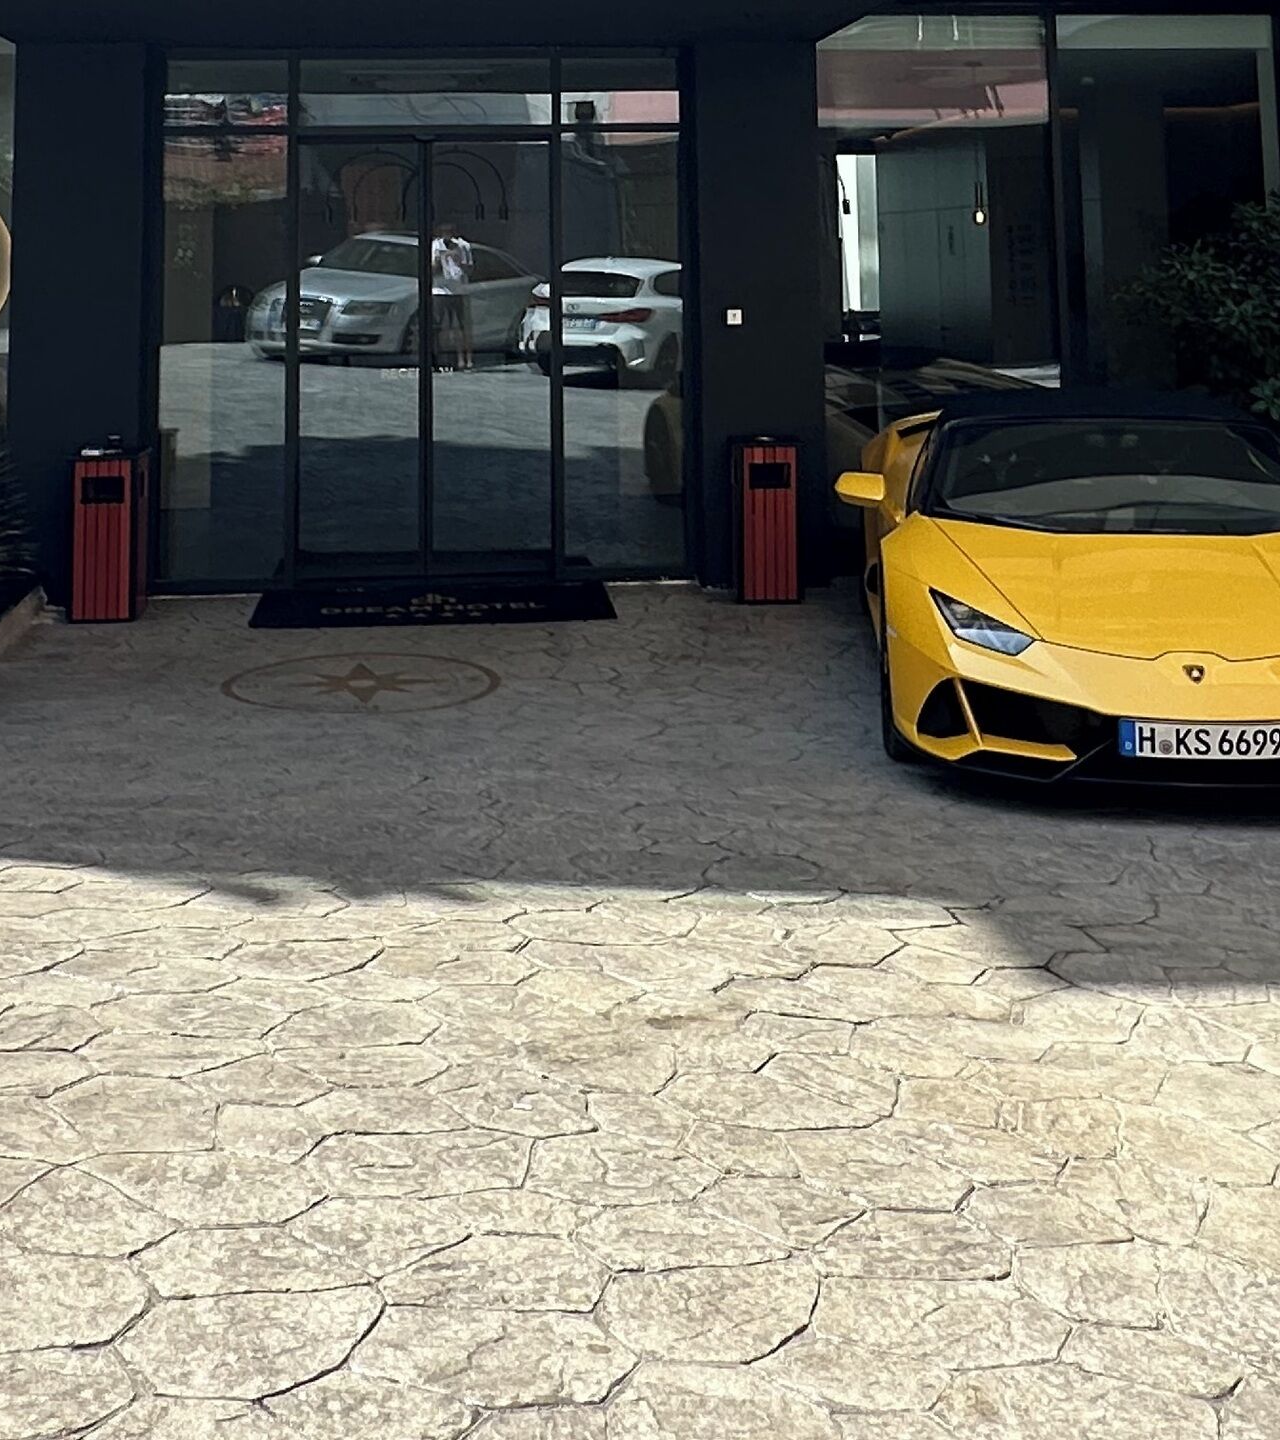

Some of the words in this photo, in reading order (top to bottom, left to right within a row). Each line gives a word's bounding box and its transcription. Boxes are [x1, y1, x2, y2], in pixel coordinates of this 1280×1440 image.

[320, 605, 433, 616] DREAM
[443, 601, 546, 612] HOTEL
[1137, 726, 1156, 754] H
[1175, 728, 1212, 756] KS
